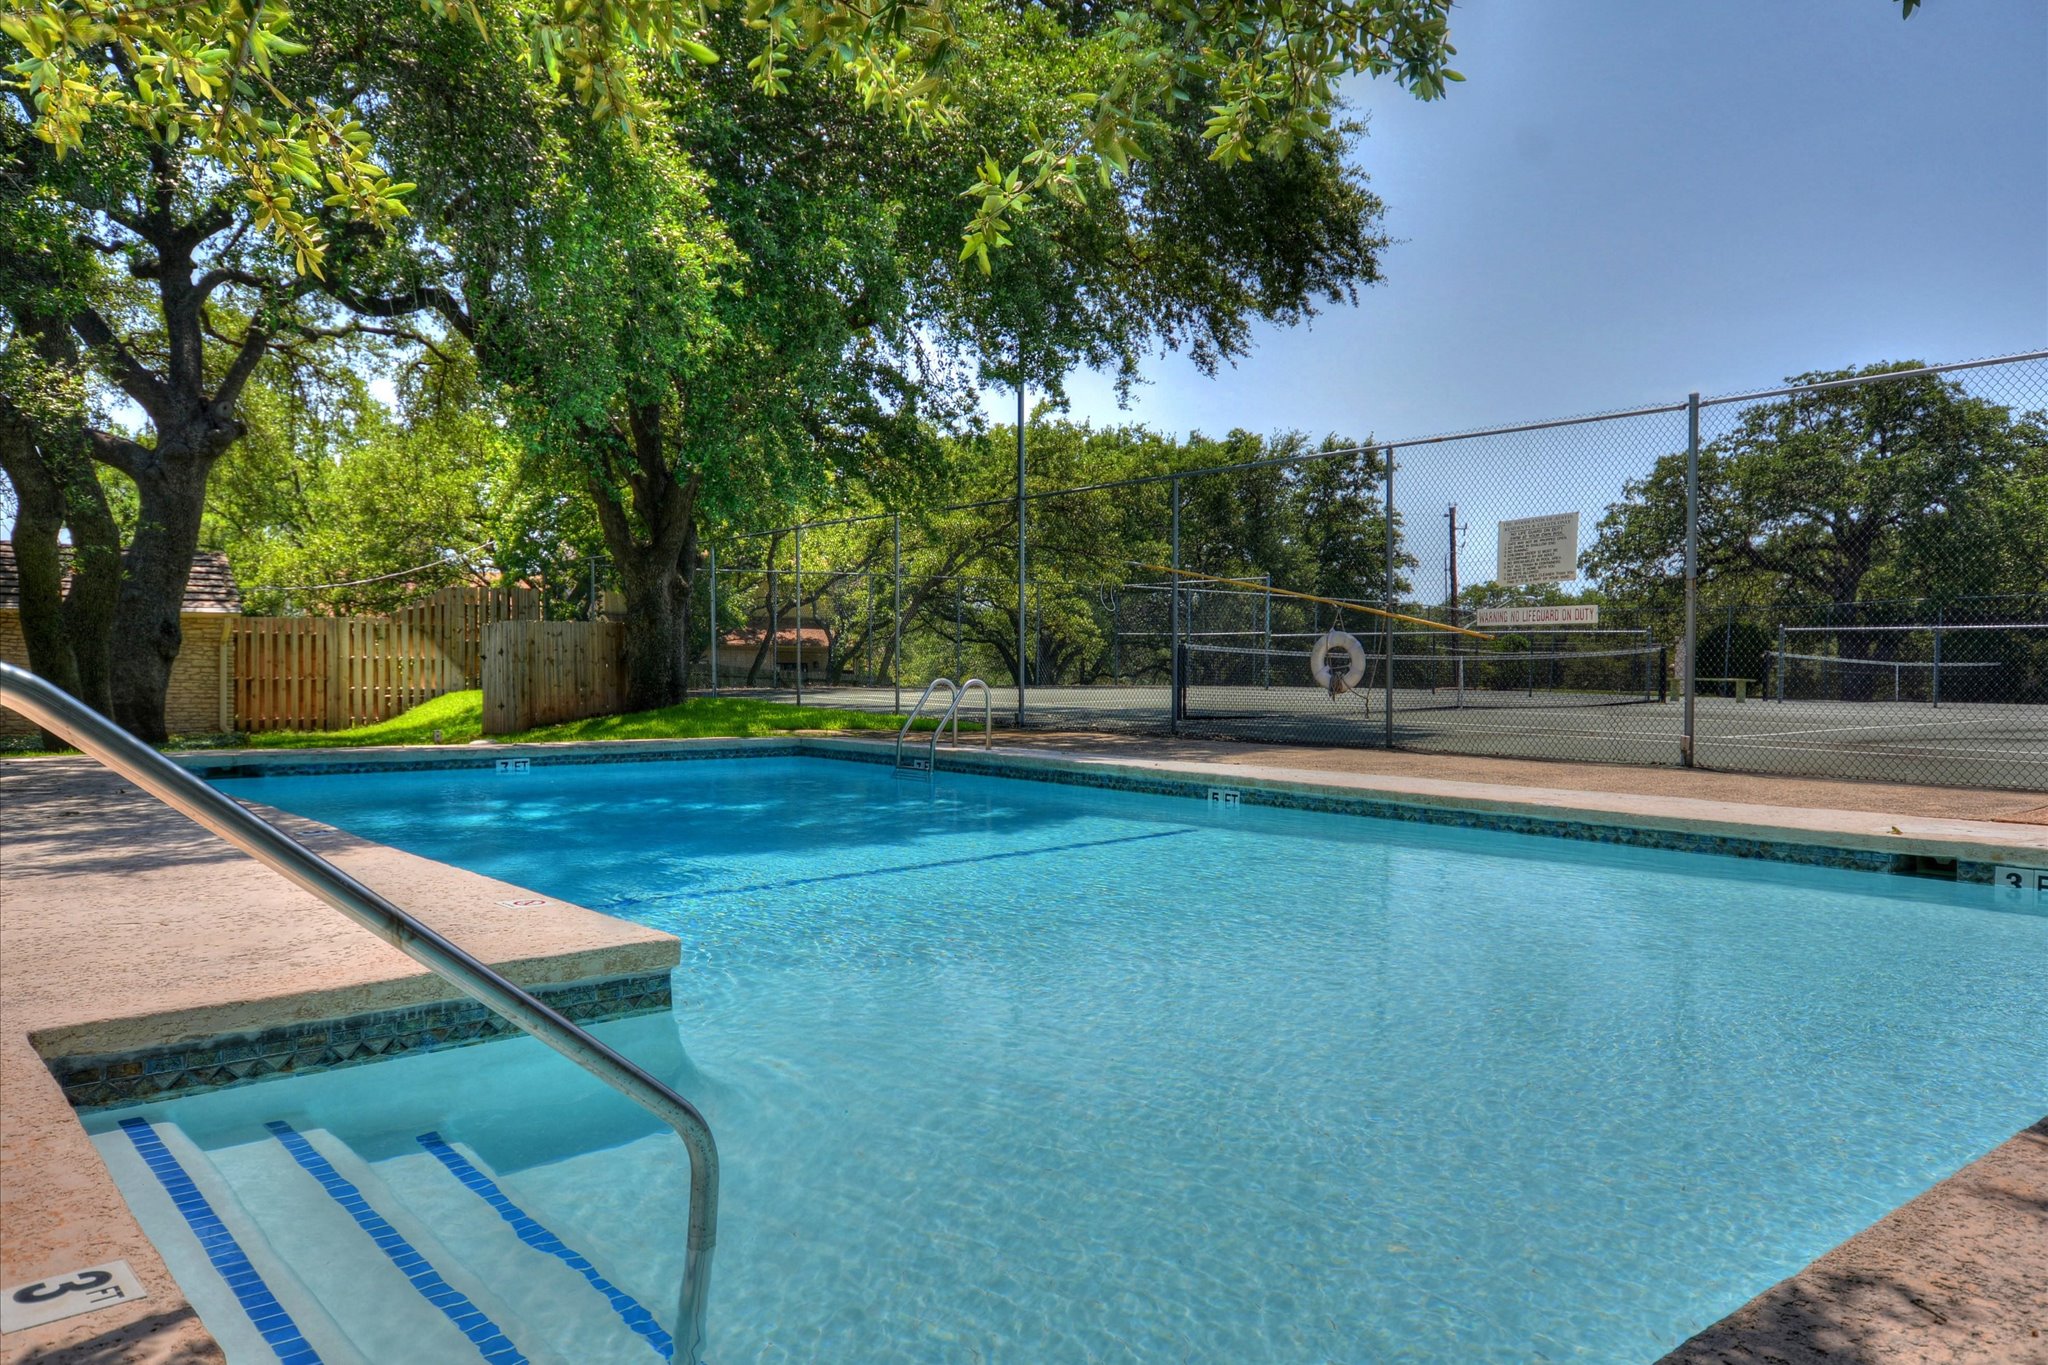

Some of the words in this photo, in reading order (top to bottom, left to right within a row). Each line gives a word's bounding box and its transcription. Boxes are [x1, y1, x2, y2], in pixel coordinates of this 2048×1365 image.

[1479, 611, 1508, 623] WARNING
[1511, 610, 1520, 622] NO
[1522, 609, 1559, 622] LIFEGUARD
[1562, 609, 1572, 621] ON
[1575, 608, 1594, 620] DUTY
[1212, 792, 1219, 802] 5
[1225, 793, 1238, 803] FT
[2006, 872, 2022, 888] 3
[13, 1270, 112, 1304] 3
[86, 1285, 125, 1304] FT
